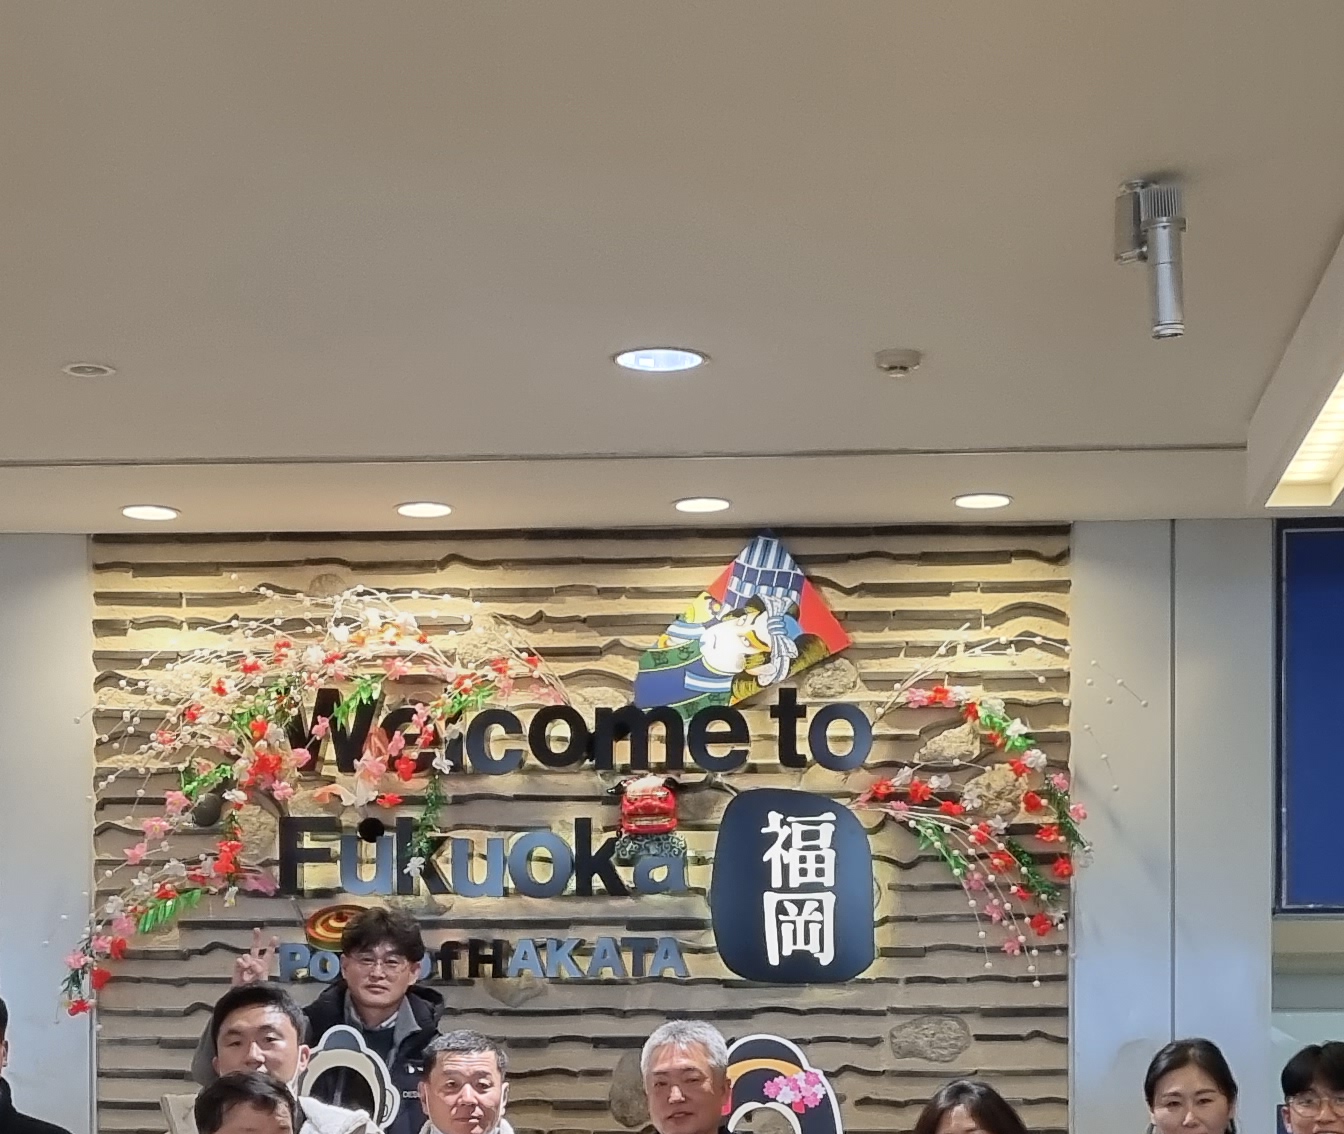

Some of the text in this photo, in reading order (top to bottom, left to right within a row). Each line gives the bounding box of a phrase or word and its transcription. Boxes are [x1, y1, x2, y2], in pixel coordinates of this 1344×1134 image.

[769, 687, 874, 772] to
[279, 816, 689, 898] Fukuoka
[760, 810, 837, 967] 福岡
[467, 937, 692, 979] HAKATA
